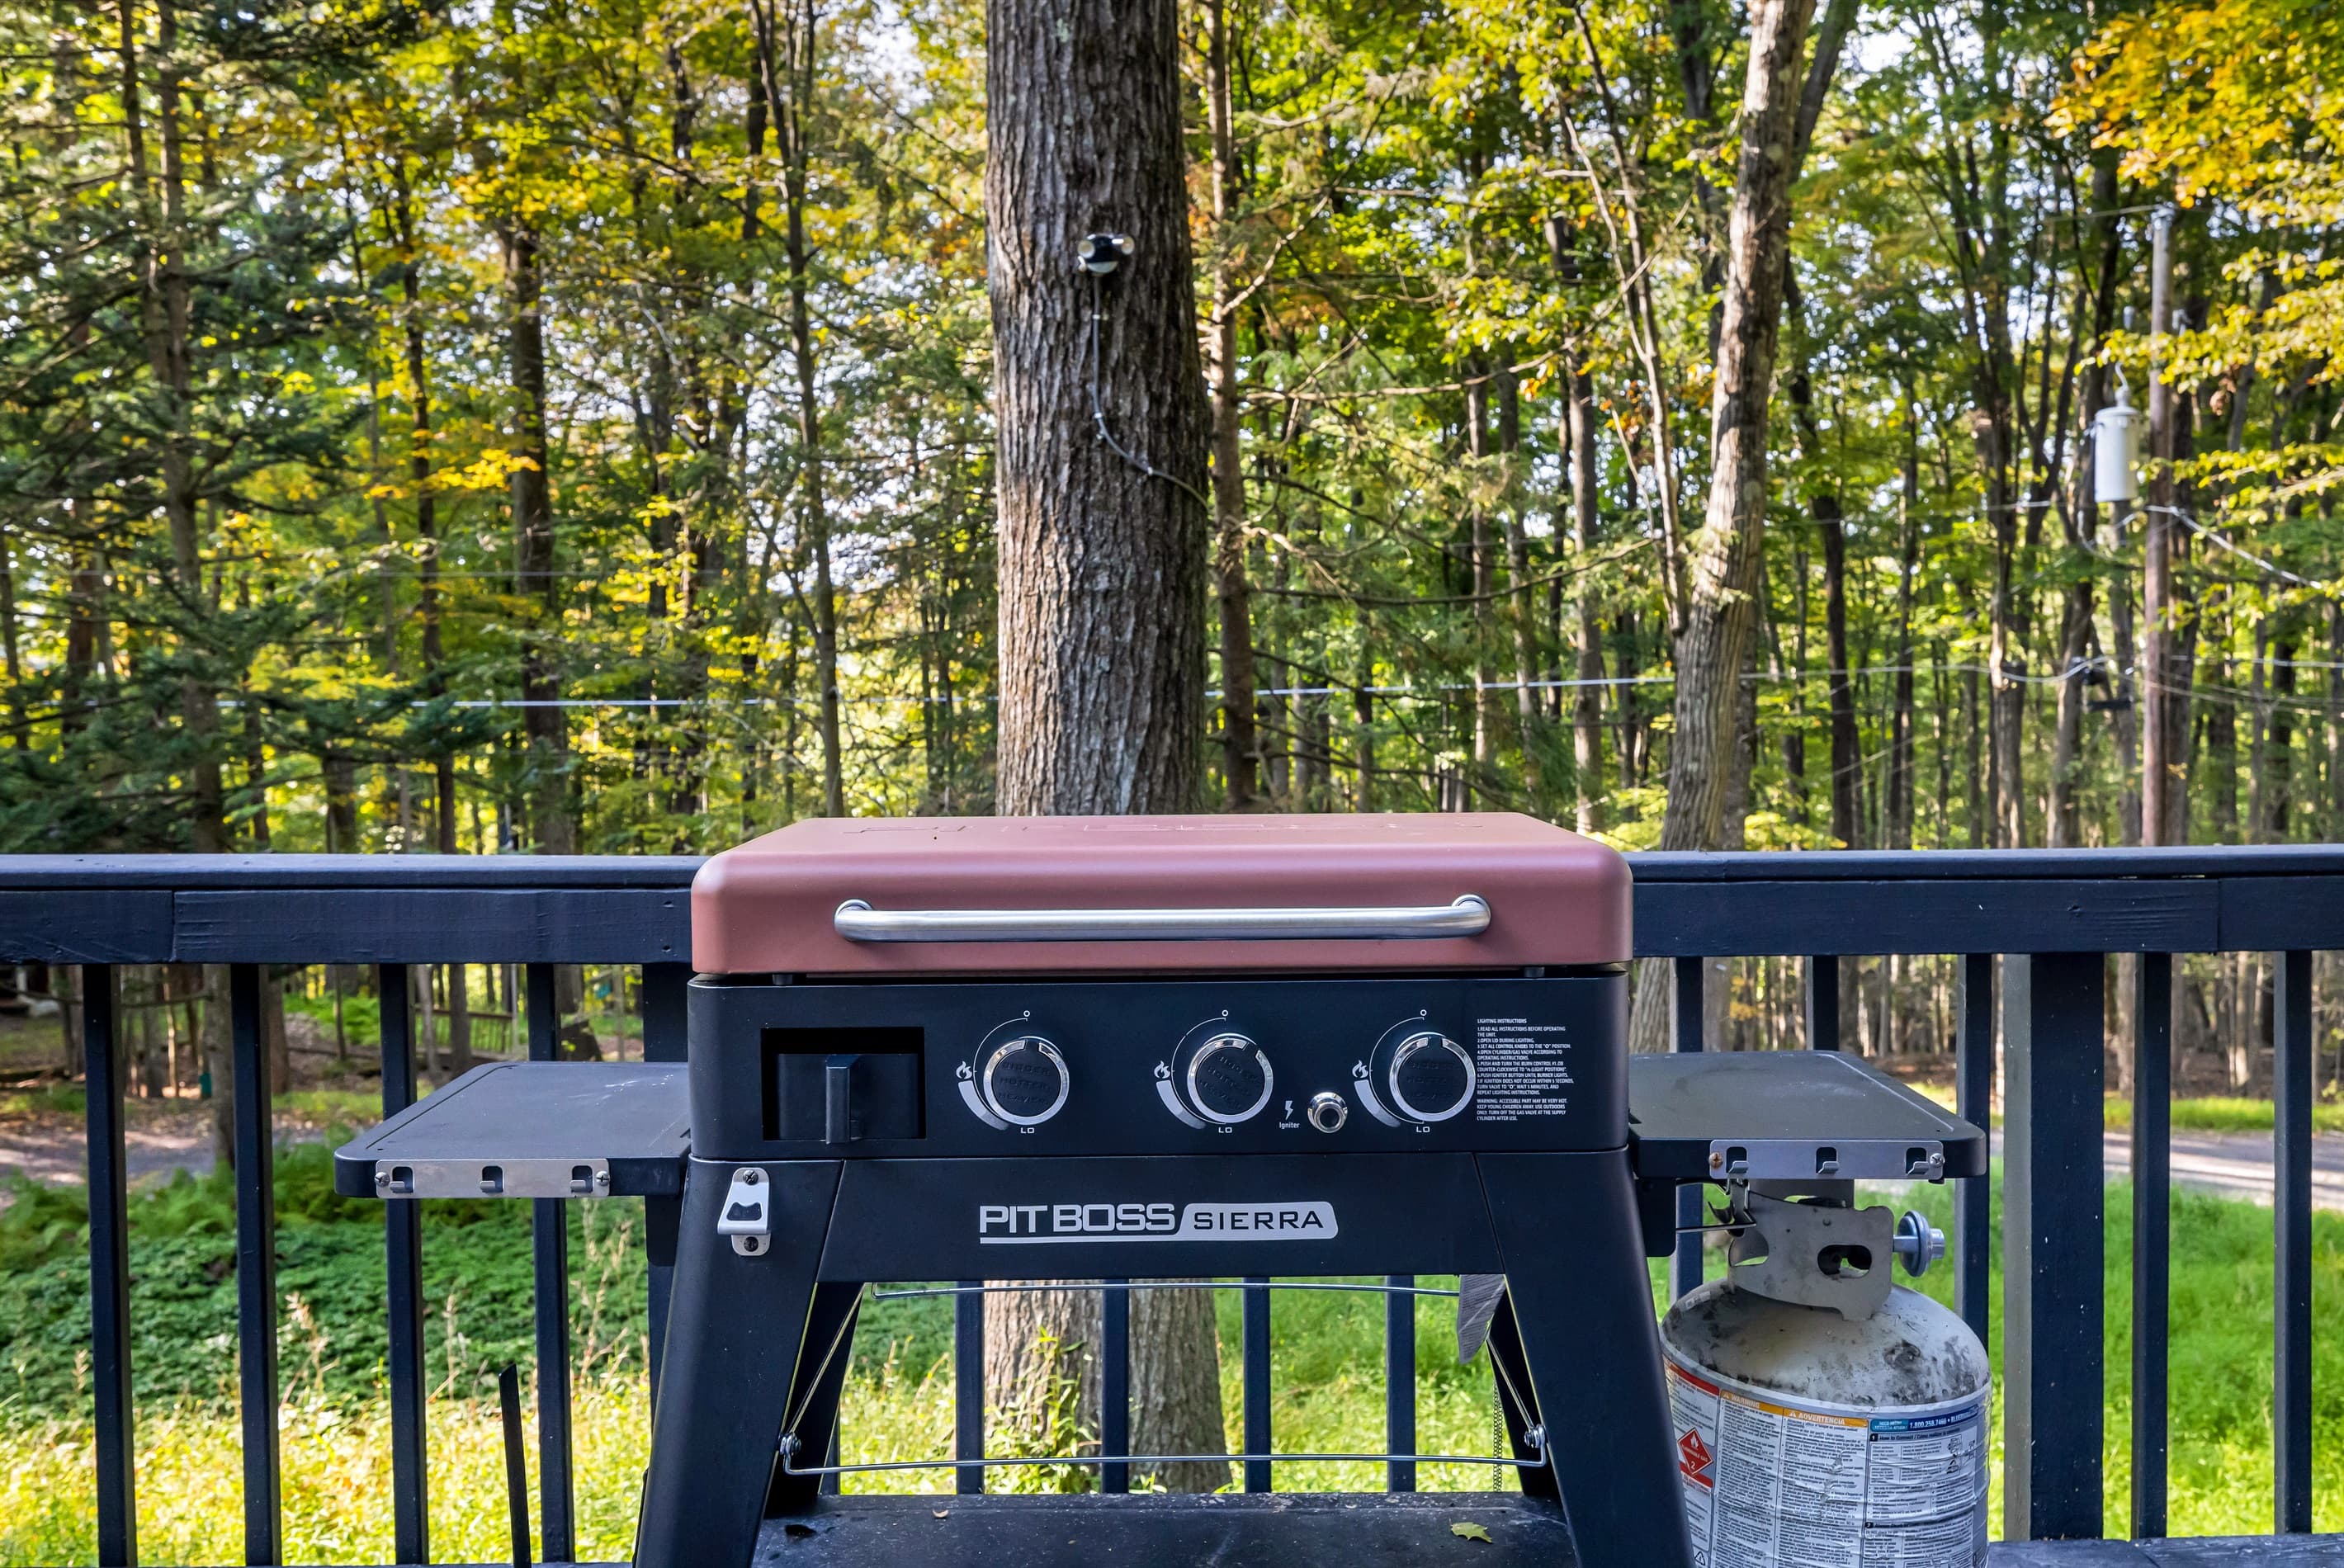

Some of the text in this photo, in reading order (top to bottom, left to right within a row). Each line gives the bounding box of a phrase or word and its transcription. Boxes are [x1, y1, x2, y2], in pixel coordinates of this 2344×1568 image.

[980, 1203, 1325, 1233] PIT BOSS SIERRA
[1731, 1393, 1760, 1408] WARNING
[1798, 1412, 1845, 1425] ADVERTENCIA
[1691, 1461, 1696, 1470] 2
